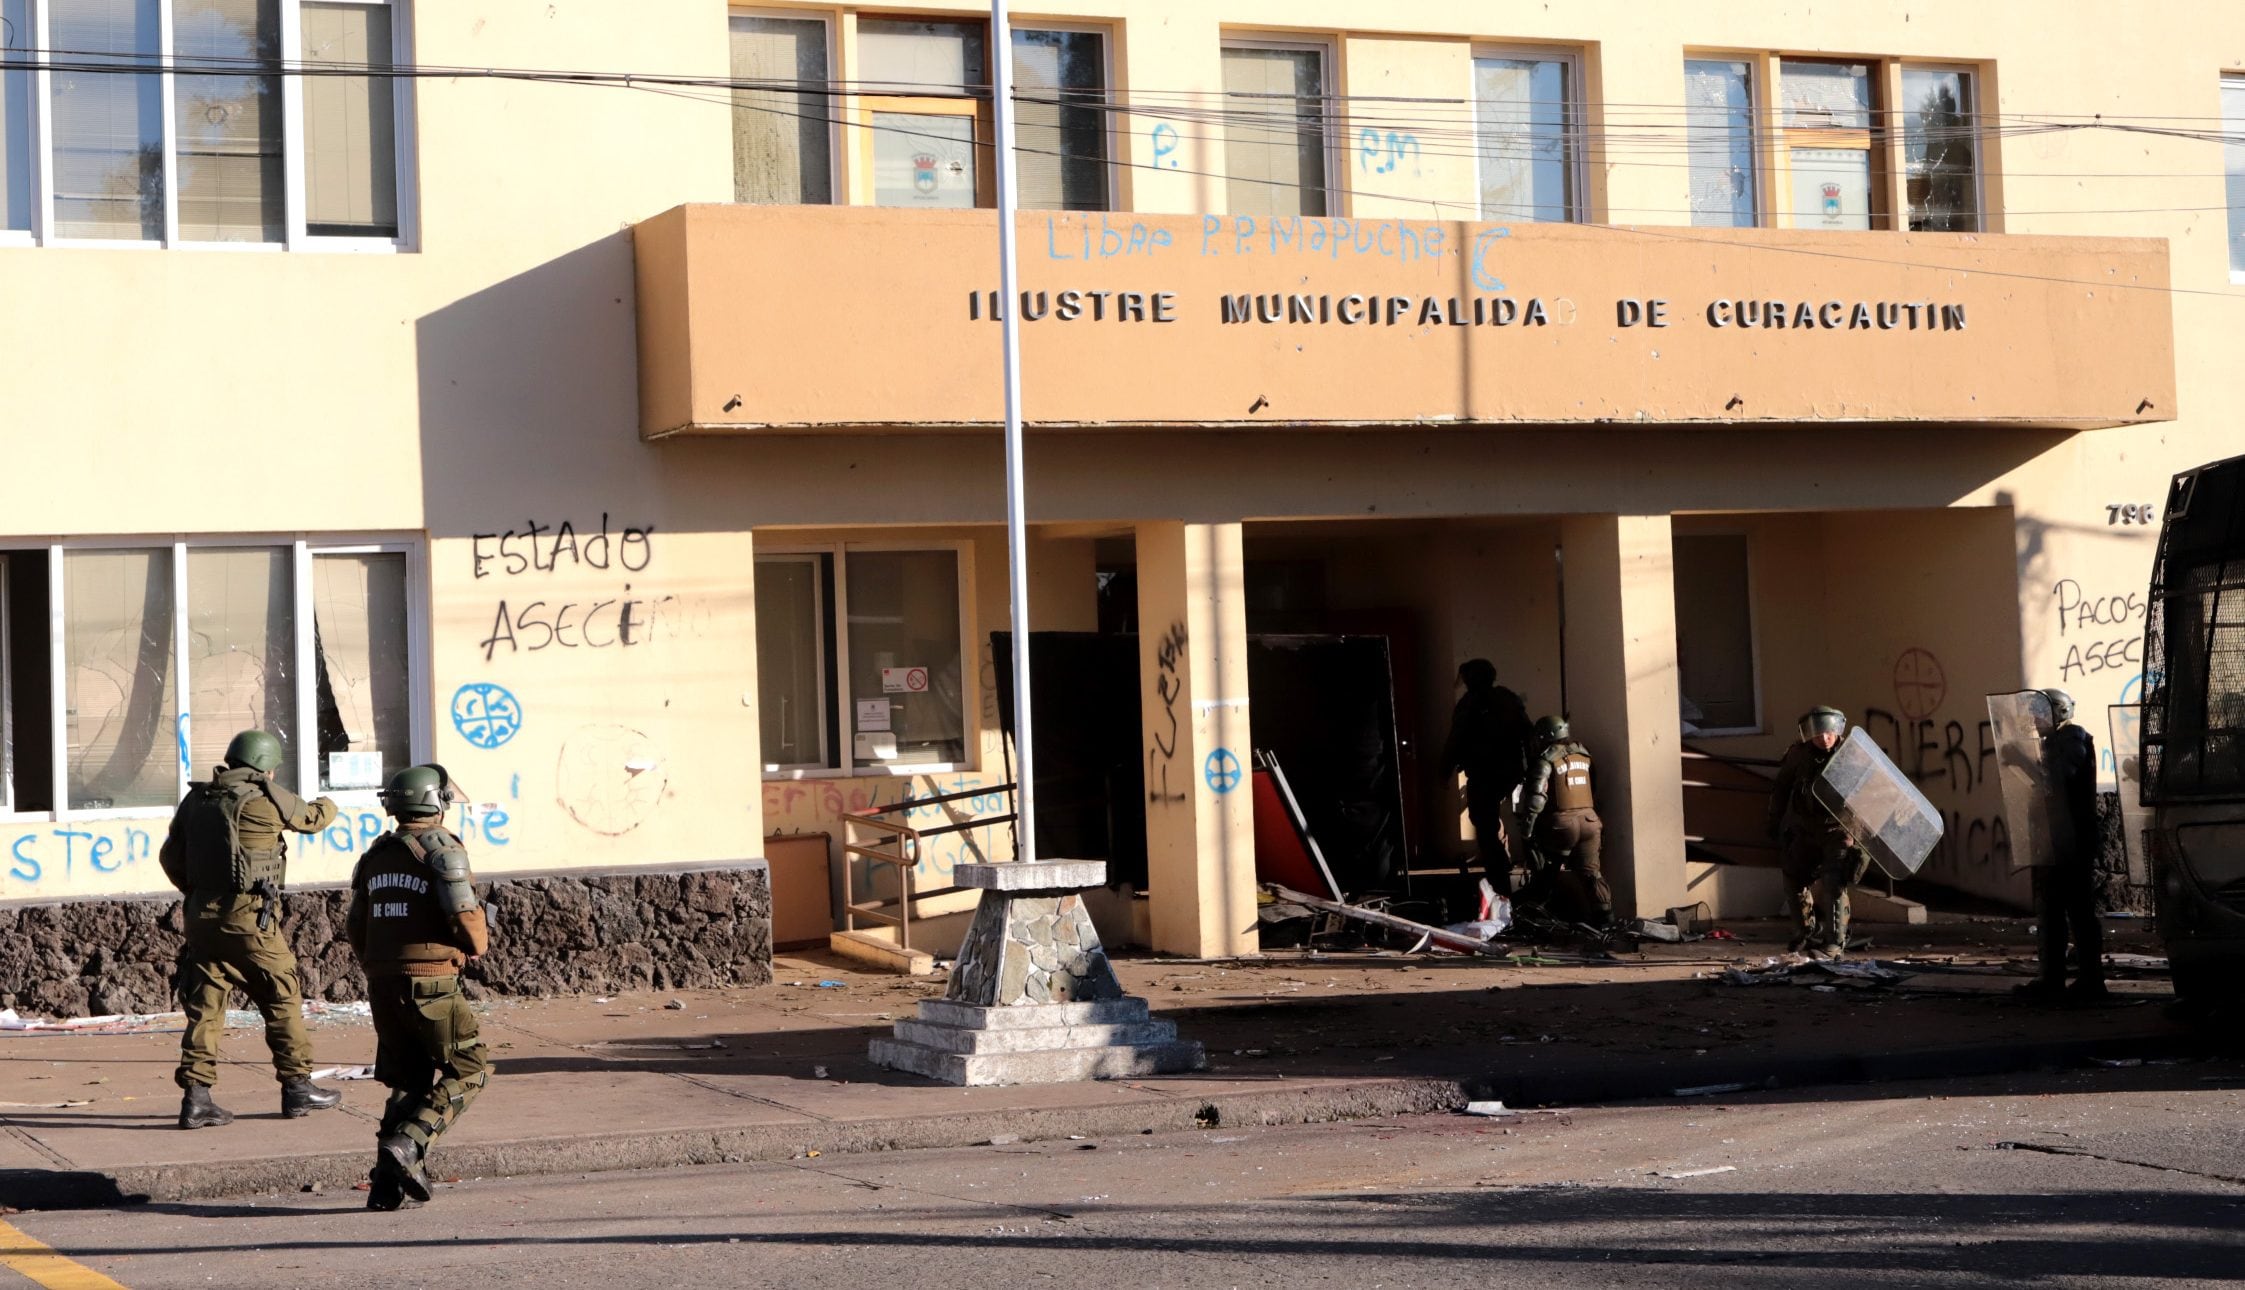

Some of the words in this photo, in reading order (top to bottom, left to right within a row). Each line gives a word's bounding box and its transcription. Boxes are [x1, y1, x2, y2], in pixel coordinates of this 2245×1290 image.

[968, 290, 1178, 323] ILUSTRE
[1616, 299, 1669, 328] DE
[1705, 299, 1967, 332] CURACAUTIN
[2106, 503, 2155, 526] 796
[2053, 578, 2146, 637] PACOS
[366, 872, 429, 896] ARABINEROS
[373, 903, 382, 918] DE
[384, 902, 408, 917] CHILE
